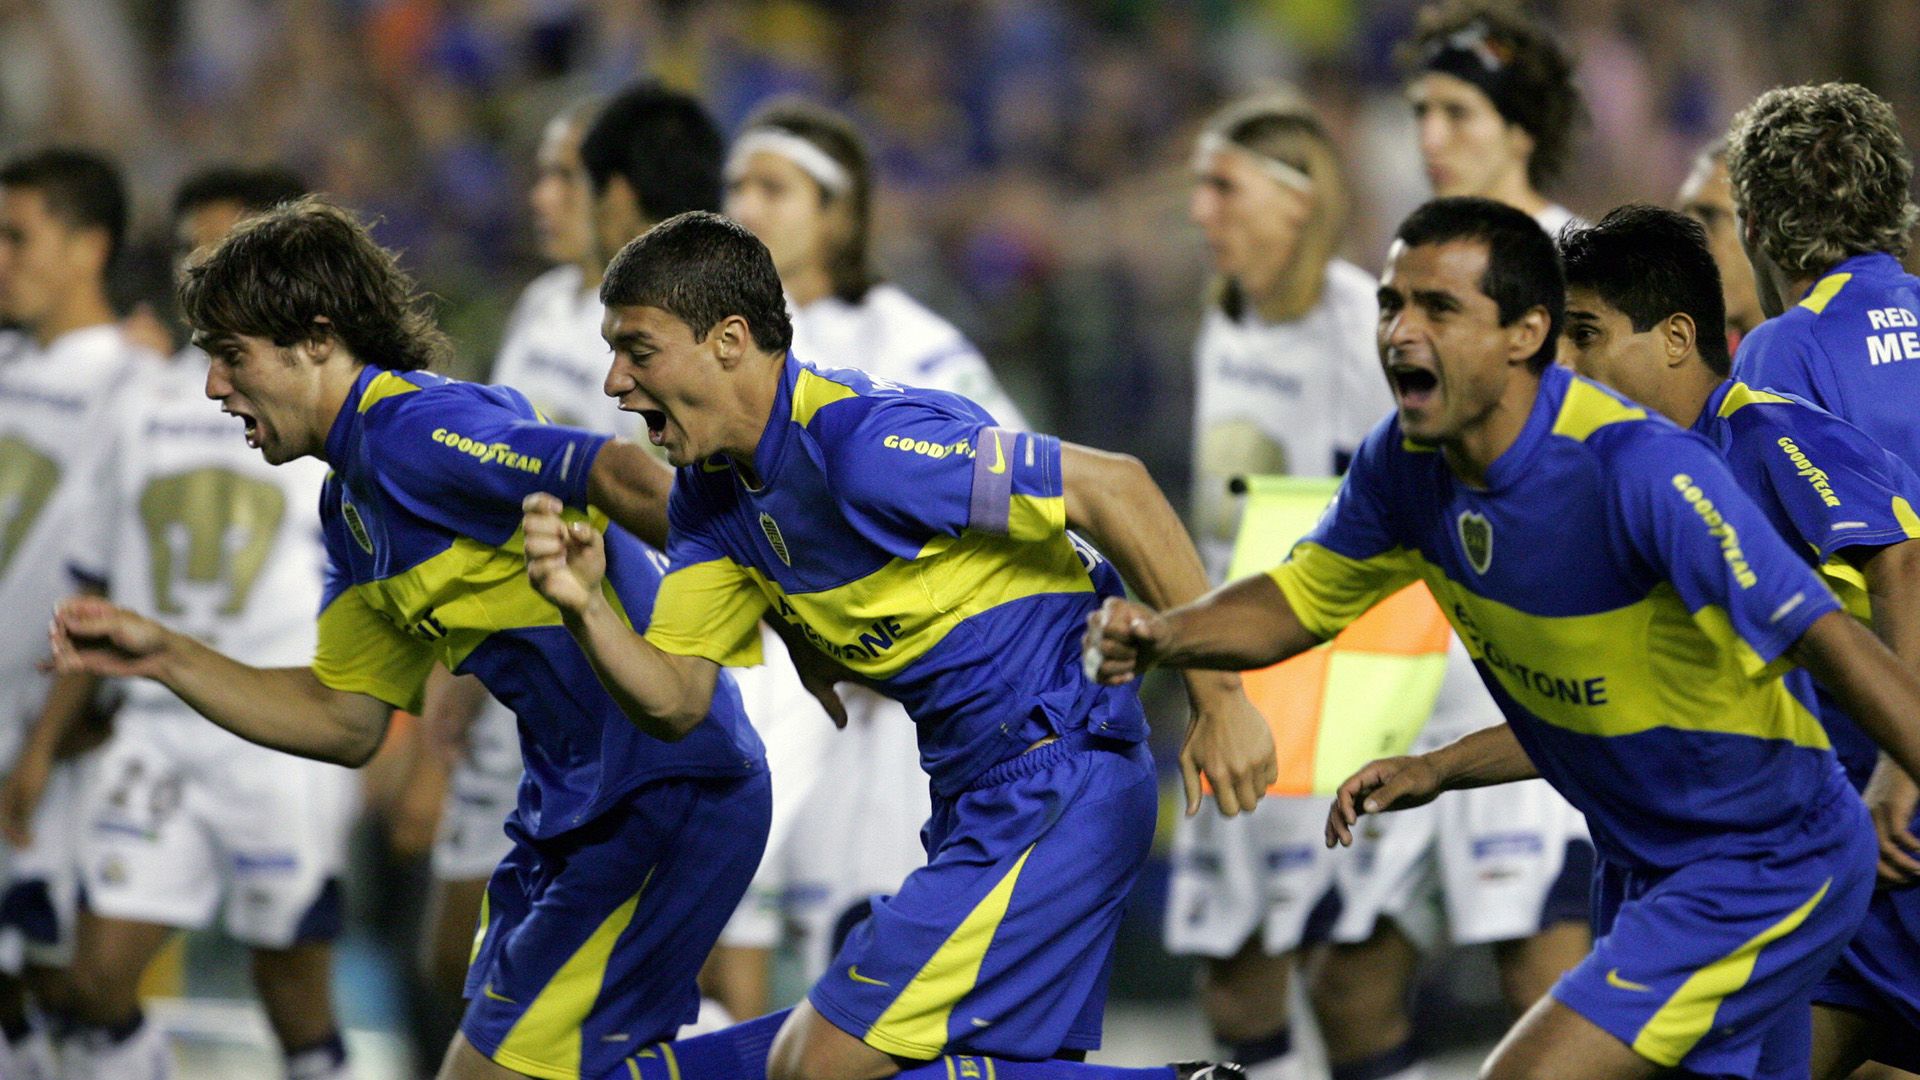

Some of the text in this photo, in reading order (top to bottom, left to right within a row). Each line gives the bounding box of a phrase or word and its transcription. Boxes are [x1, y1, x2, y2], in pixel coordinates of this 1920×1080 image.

[1867, 307, 1919, 330] RED
[431, 428, 543, 475] GOODYEAR
[1777, 436, 1841, 507] GOODYEAR
[1671, 473, 1758, 590] GOODYEAR
